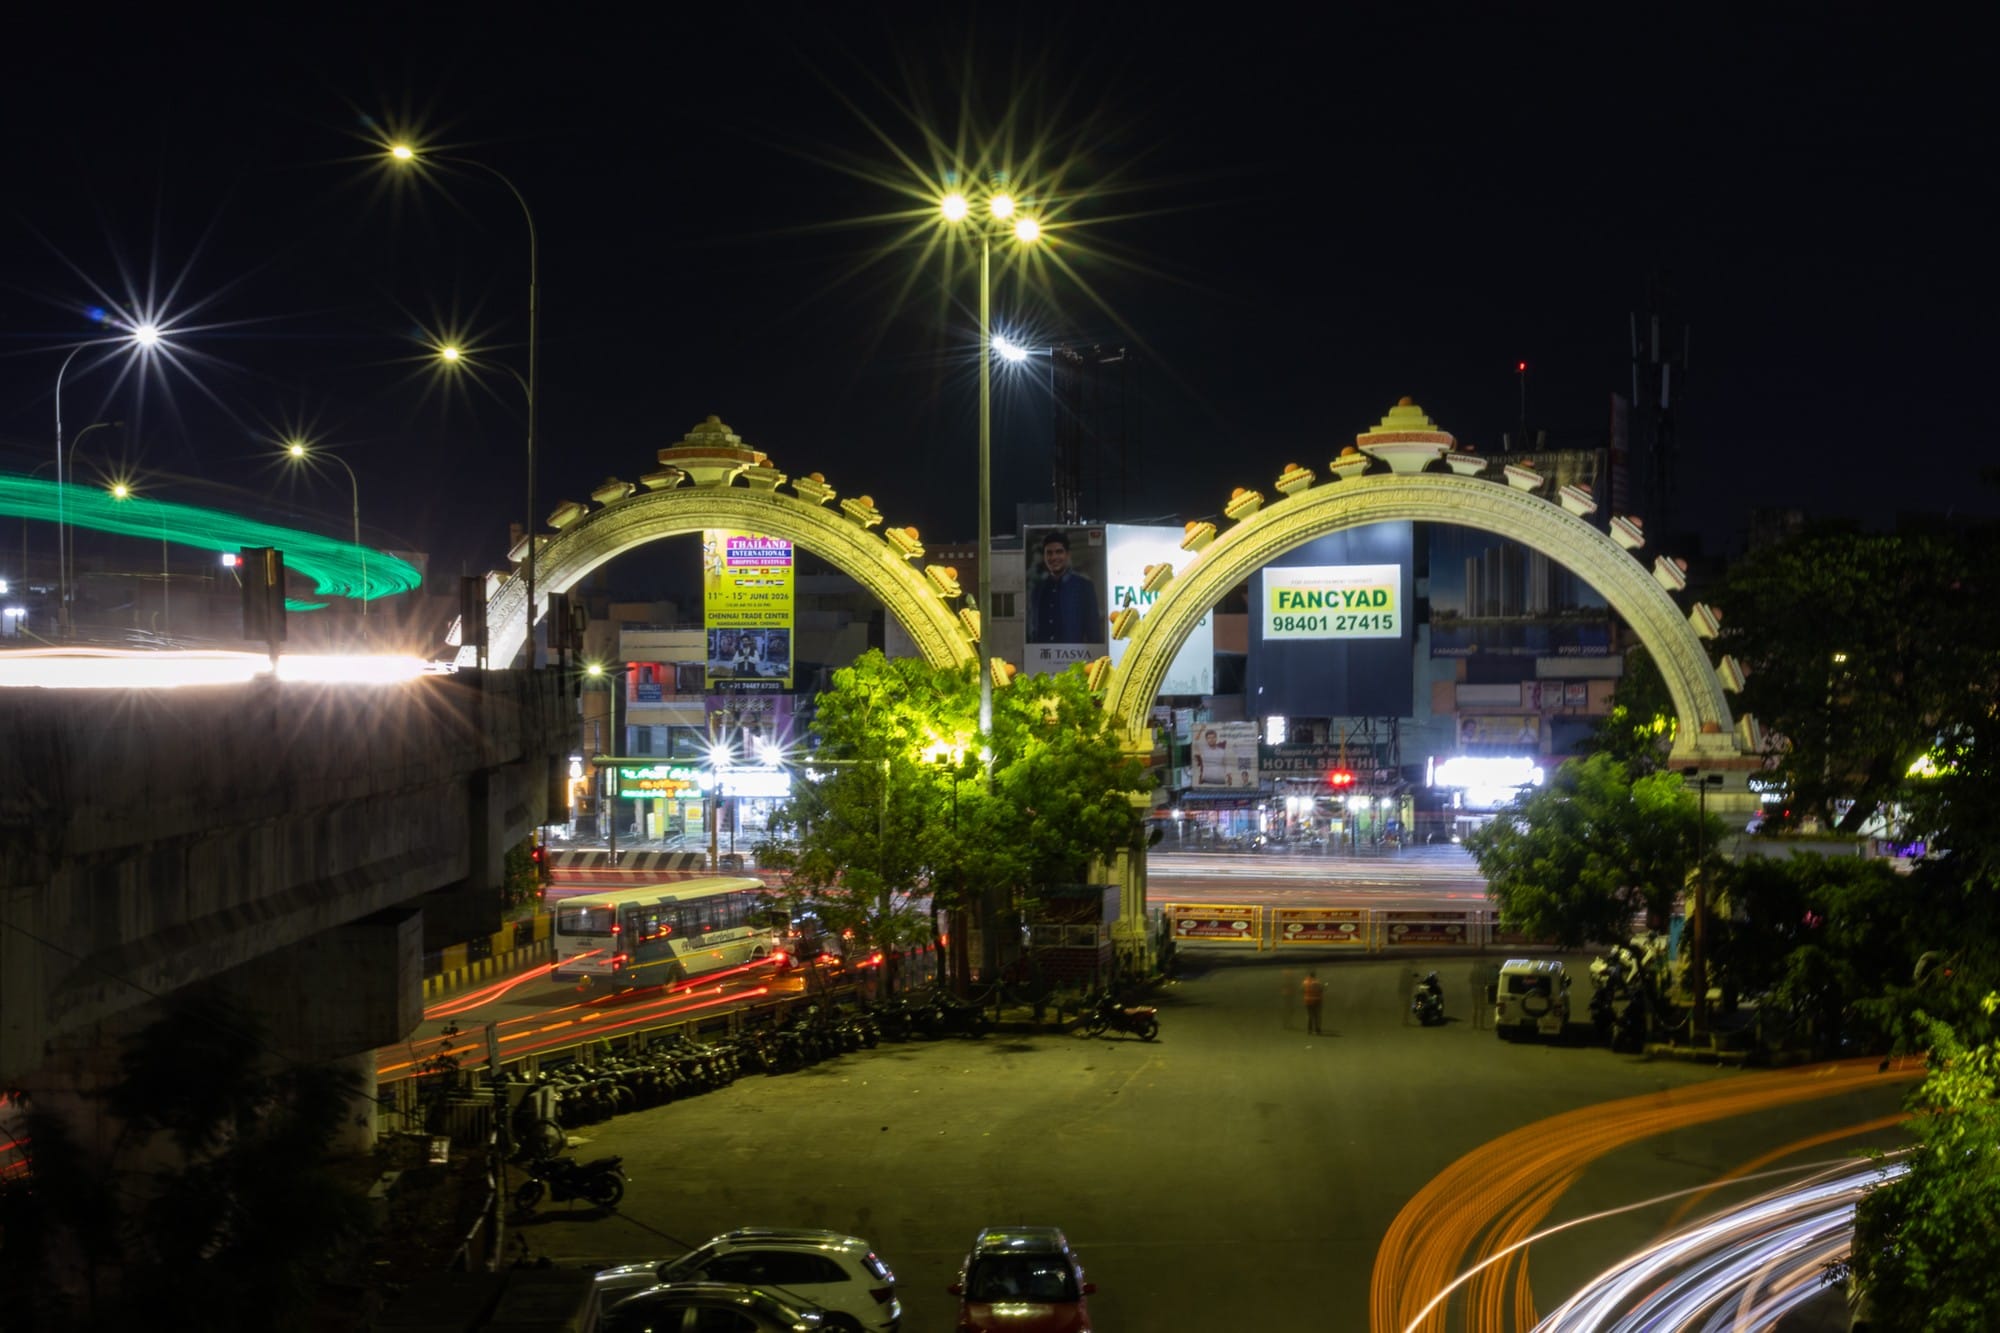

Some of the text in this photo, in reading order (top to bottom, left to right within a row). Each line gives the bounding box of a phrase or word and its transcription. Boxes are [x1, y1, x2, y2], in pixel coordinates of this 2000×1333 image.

[731, 540, 787, 548] THAILAND
[1278, 590, 1389, 609] FANCYAD
[708, 612, 789, 620] CHENNAI TRADE CENTRE
[1273, 614, 1393, 632] 98401 27415
[1055, 648, 1092, 659] TASVA
[1263, 758, 1313, 770] HOTEL
